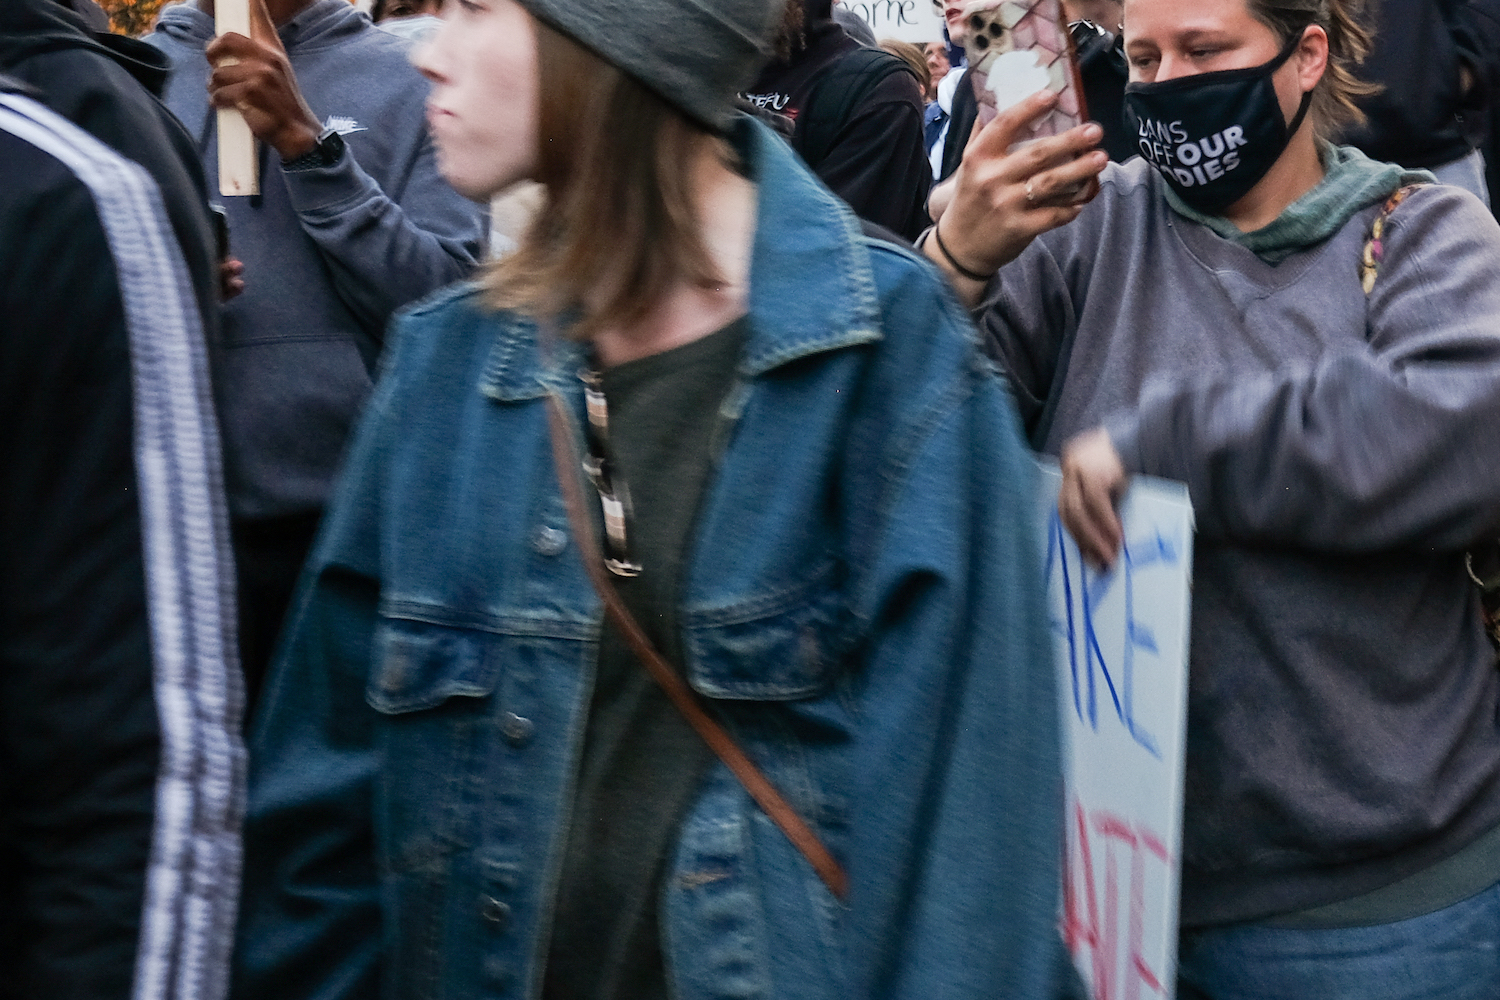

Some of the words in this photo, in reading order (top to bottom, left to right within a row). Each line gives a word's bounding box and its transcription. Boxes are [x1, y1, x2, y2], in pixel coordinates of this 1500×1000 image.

[1139, 138, 1173, 166] OFF
[1176, 124, 1249, 167] OUR
[1150, 151, 1241, 188] DIES
